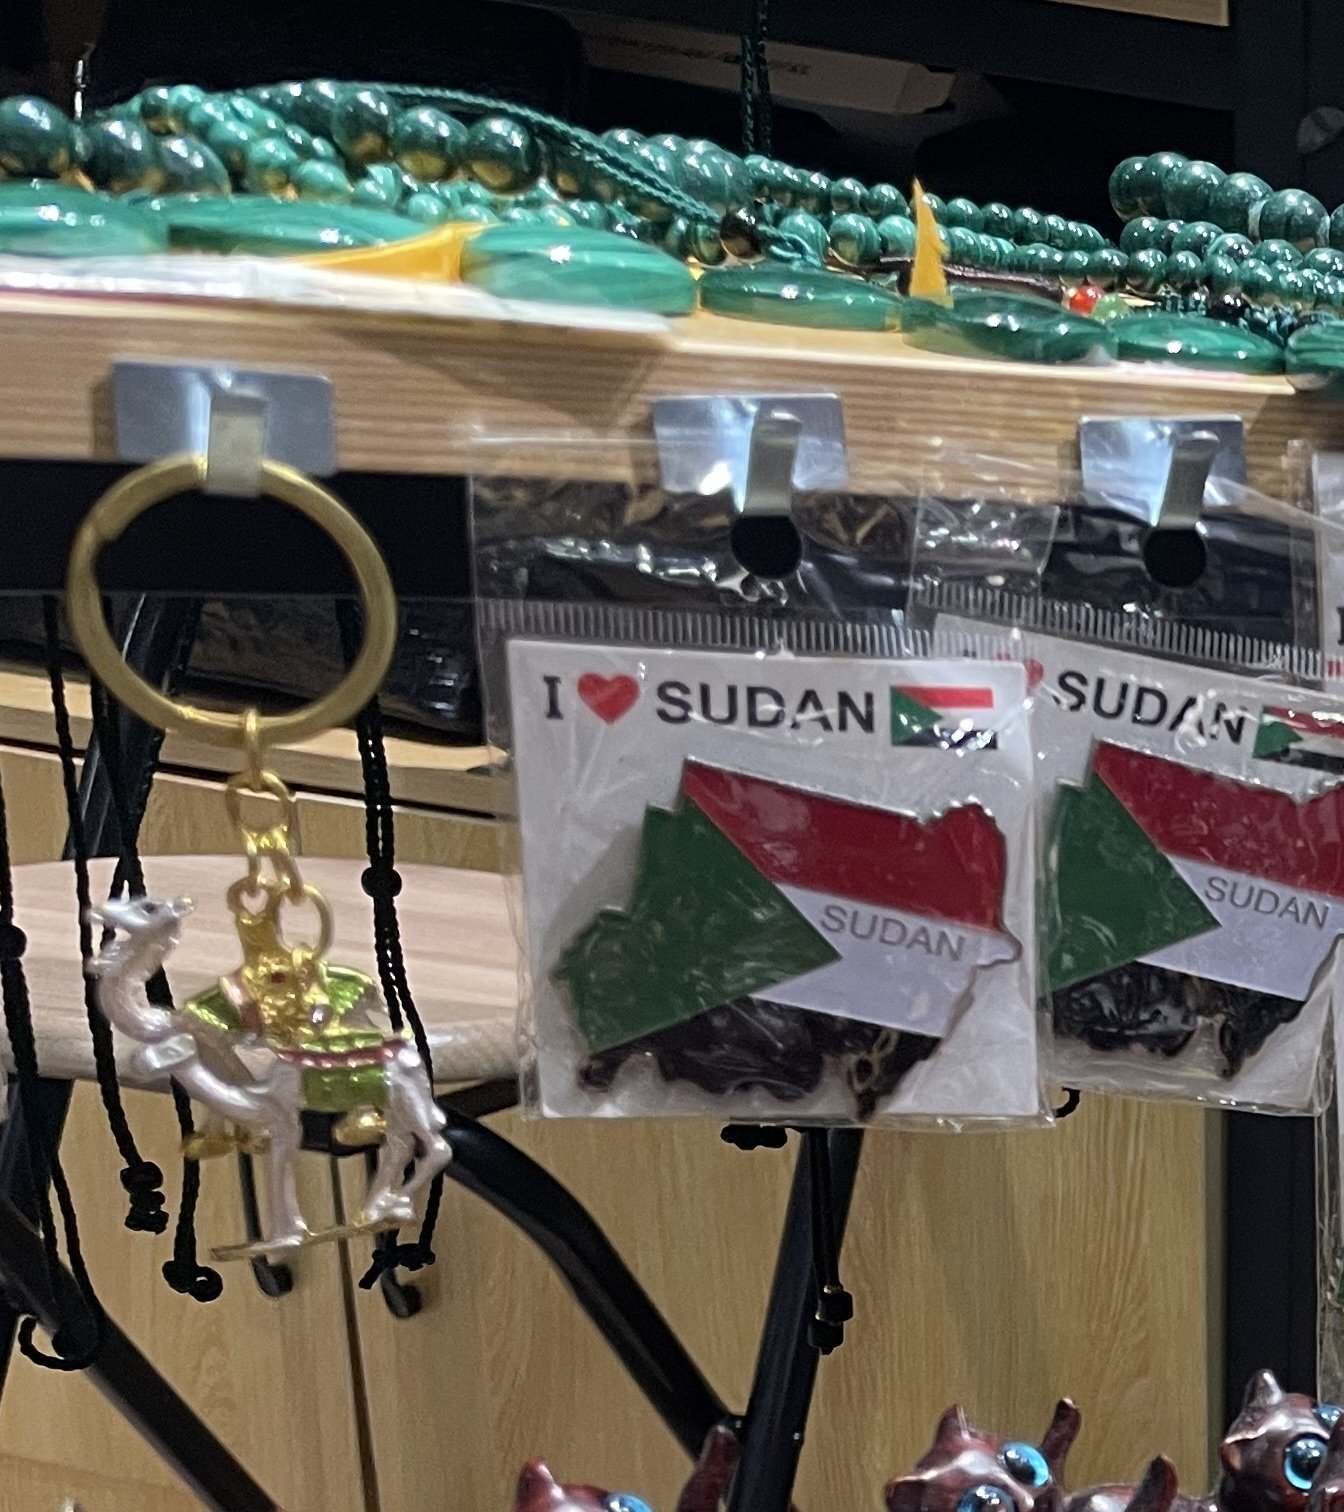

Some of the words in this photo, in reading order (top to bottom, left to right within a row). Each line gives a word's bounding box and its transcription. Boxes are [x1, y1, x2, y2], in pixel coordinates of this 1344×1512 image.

[543, 675, 565, 720] I
[656, 681, 875, 734] SUDAN
[1057, 670, 1249, 745] SUDAN
[1204, 875, 1330, 929] SUDAN
[820, 904, 966, 962] SUDAN
